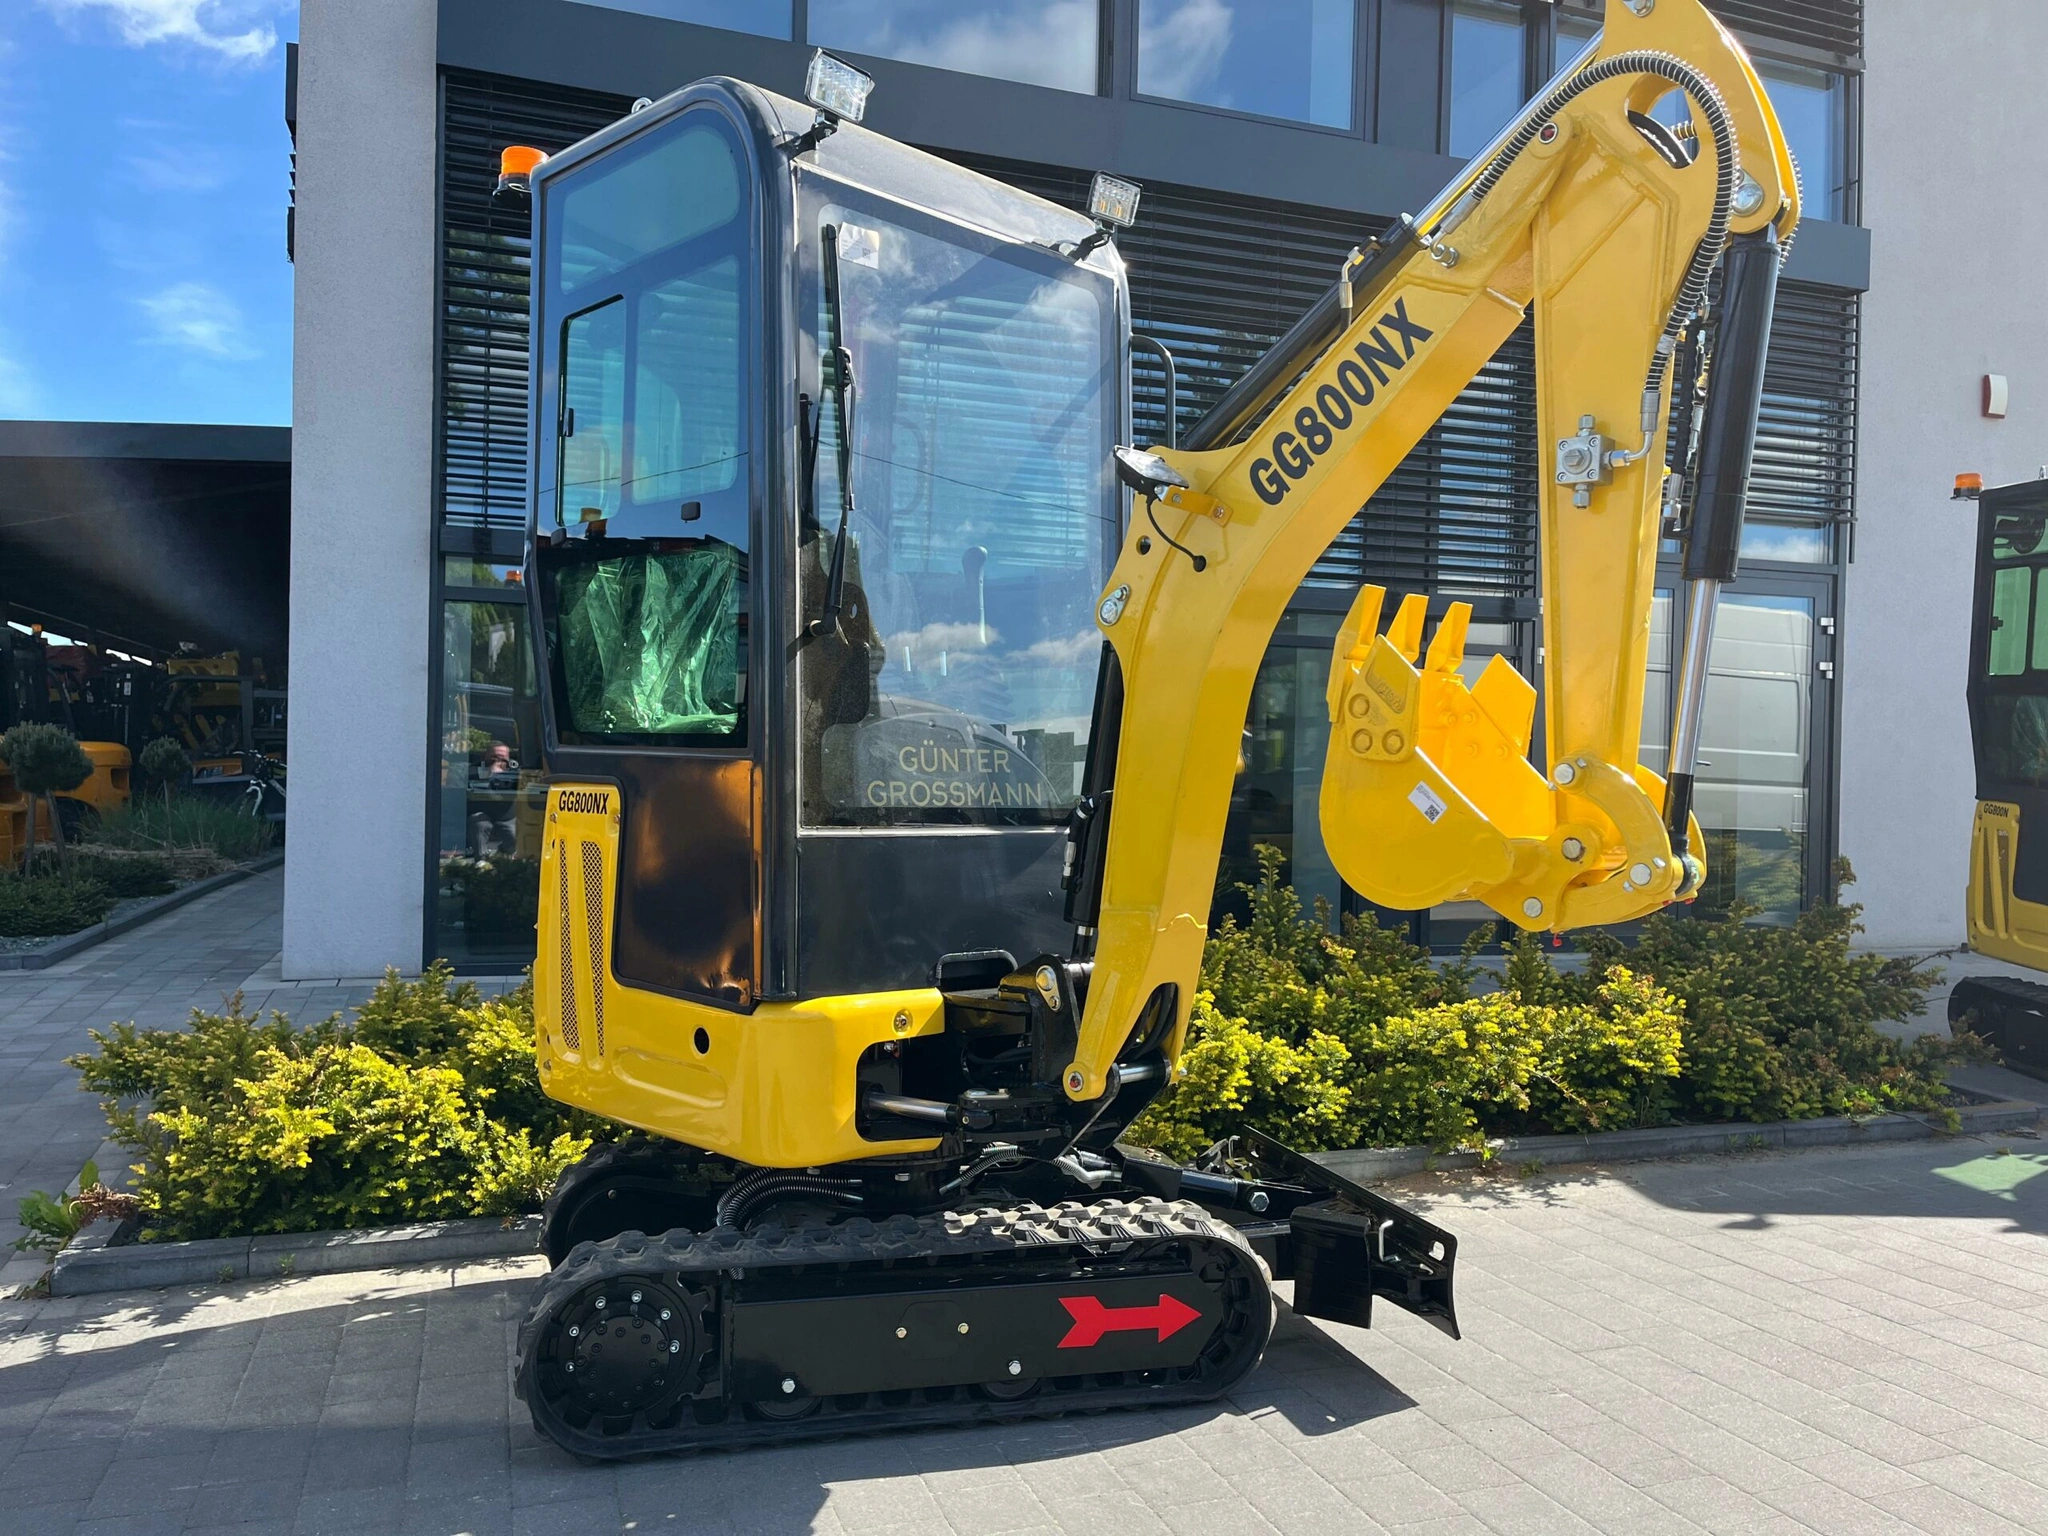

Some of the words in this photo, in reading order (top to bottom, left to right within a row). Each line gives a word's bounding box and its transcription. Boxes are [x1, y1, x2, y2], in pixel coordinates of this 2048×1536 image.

[1249, 296, 1434, 505] GG800NX
[899, 739, 1011, 773] GÜNTER
[559, 790, 609, 814] GG800NX
[867, 780, 1042, 807] GROSSMANN
